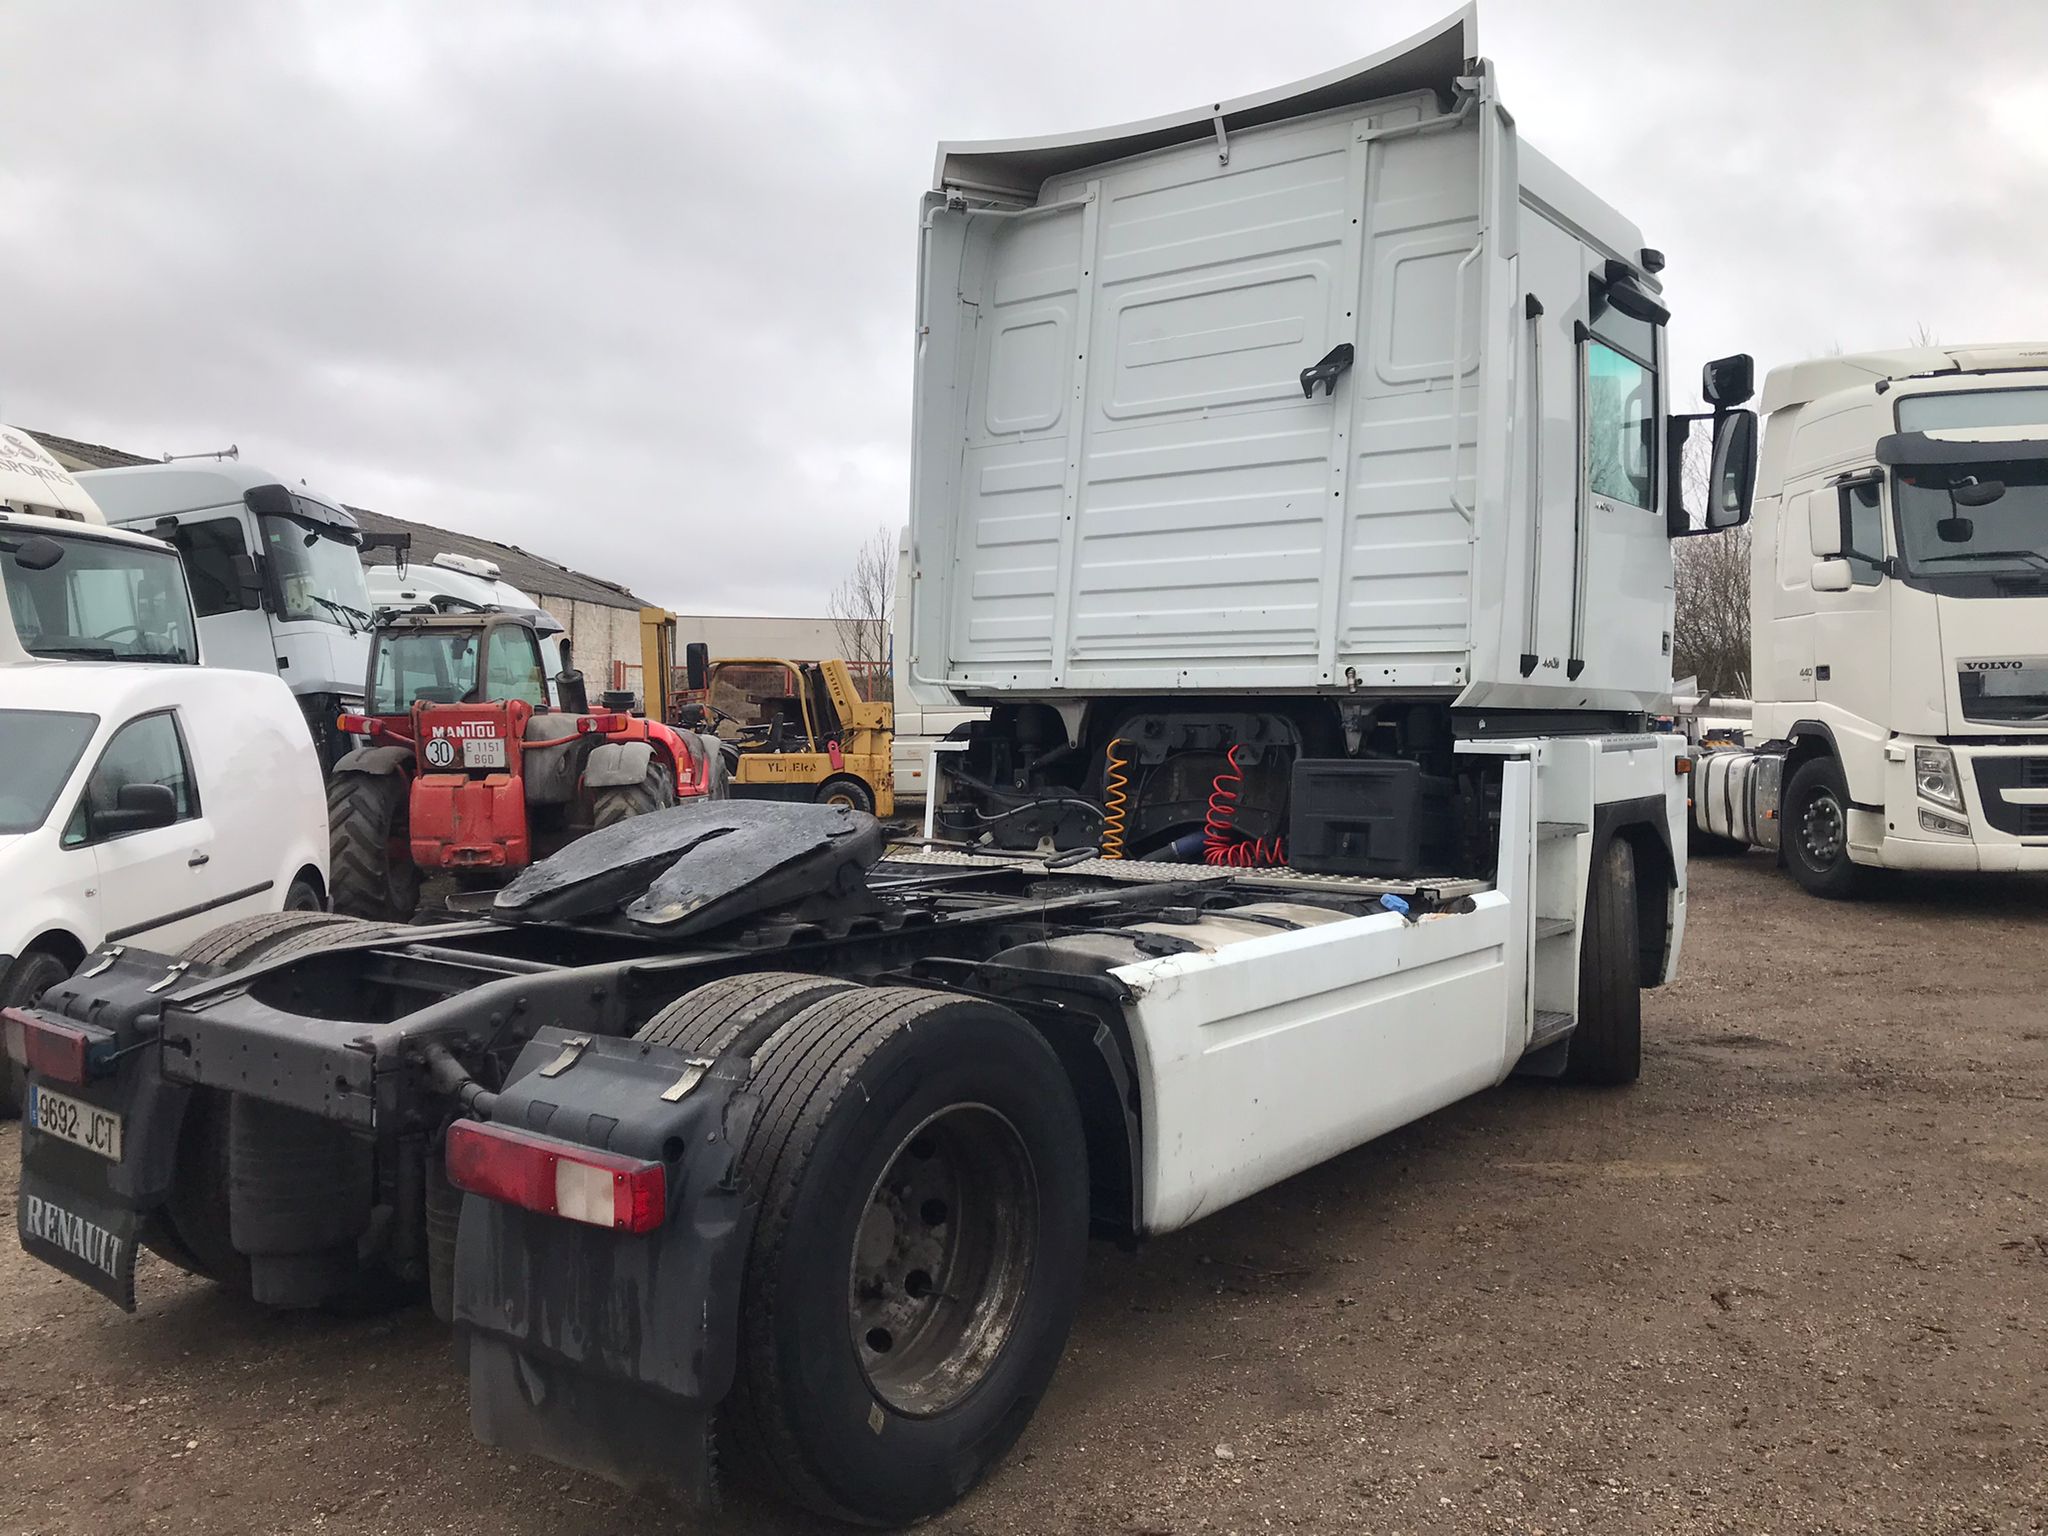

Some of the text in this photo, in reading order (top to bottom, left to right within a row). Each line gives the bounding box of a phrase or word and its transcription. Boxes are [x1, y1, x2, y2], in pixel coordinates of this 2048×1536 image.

[1964, 661, 2023, 671] VOLVO
[431, 721, 496, 738] MANITOU
[429, 741, 450, 764] 30
[466, 742, 499, 753] E 1151
[474, 754, 495, 765] BGD
[40, 1094, 116, 1154] 9692 JCT
[26, 1194, 122, 1280] RENAULT
